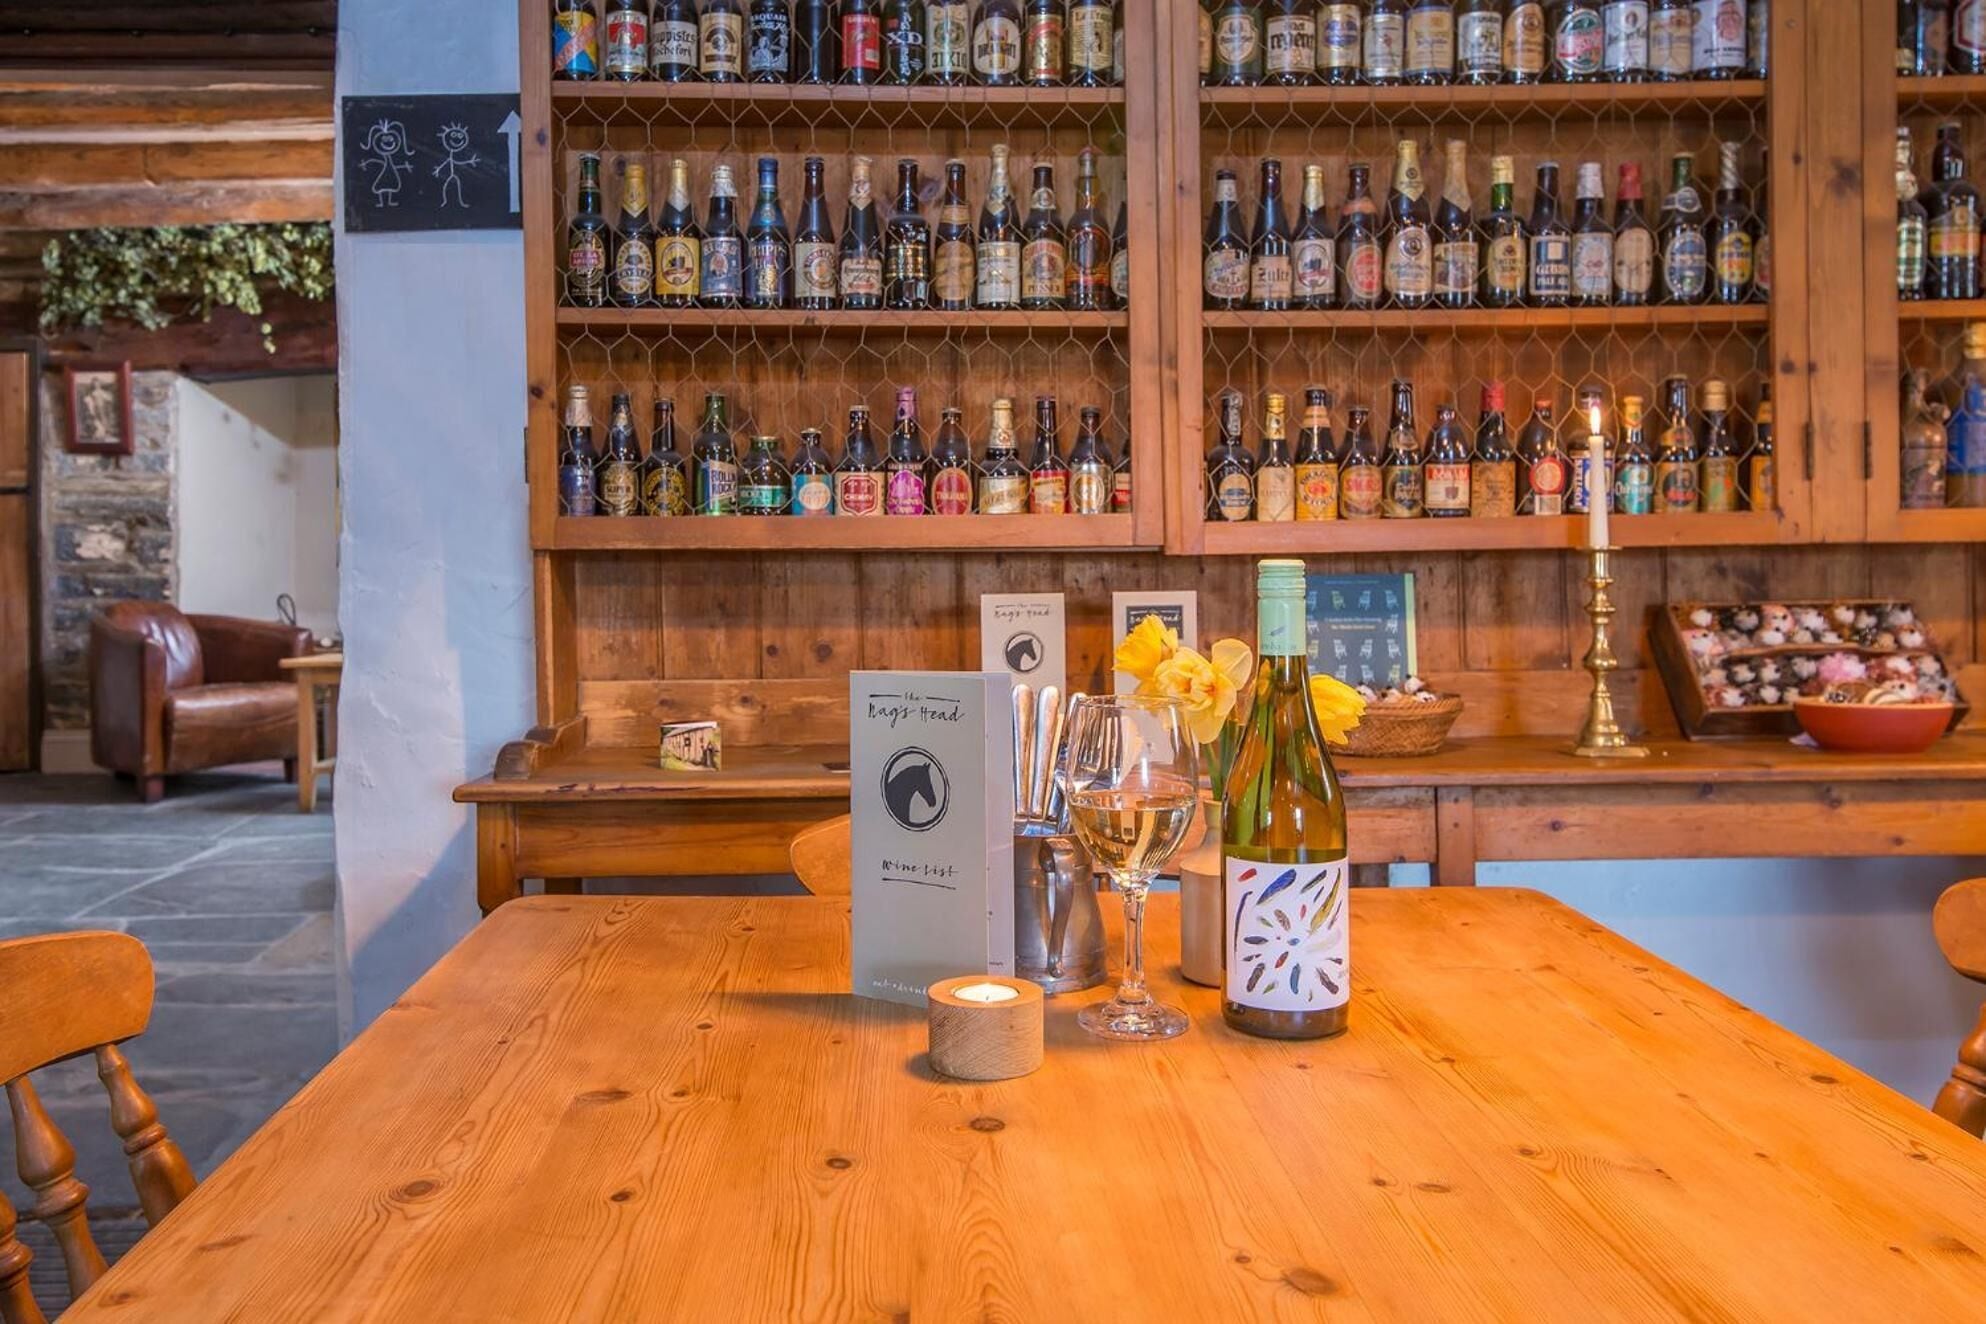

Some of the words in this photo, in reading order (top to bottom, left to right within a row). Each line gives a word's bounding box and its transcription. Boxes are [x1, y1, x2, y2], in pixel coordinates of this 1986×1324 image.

[867, 702, 916, 729] Nag's
[919, 704, 965, 722] Head
[882, 859, 920, 872] Wine
[924, 864, 960, 878] List
